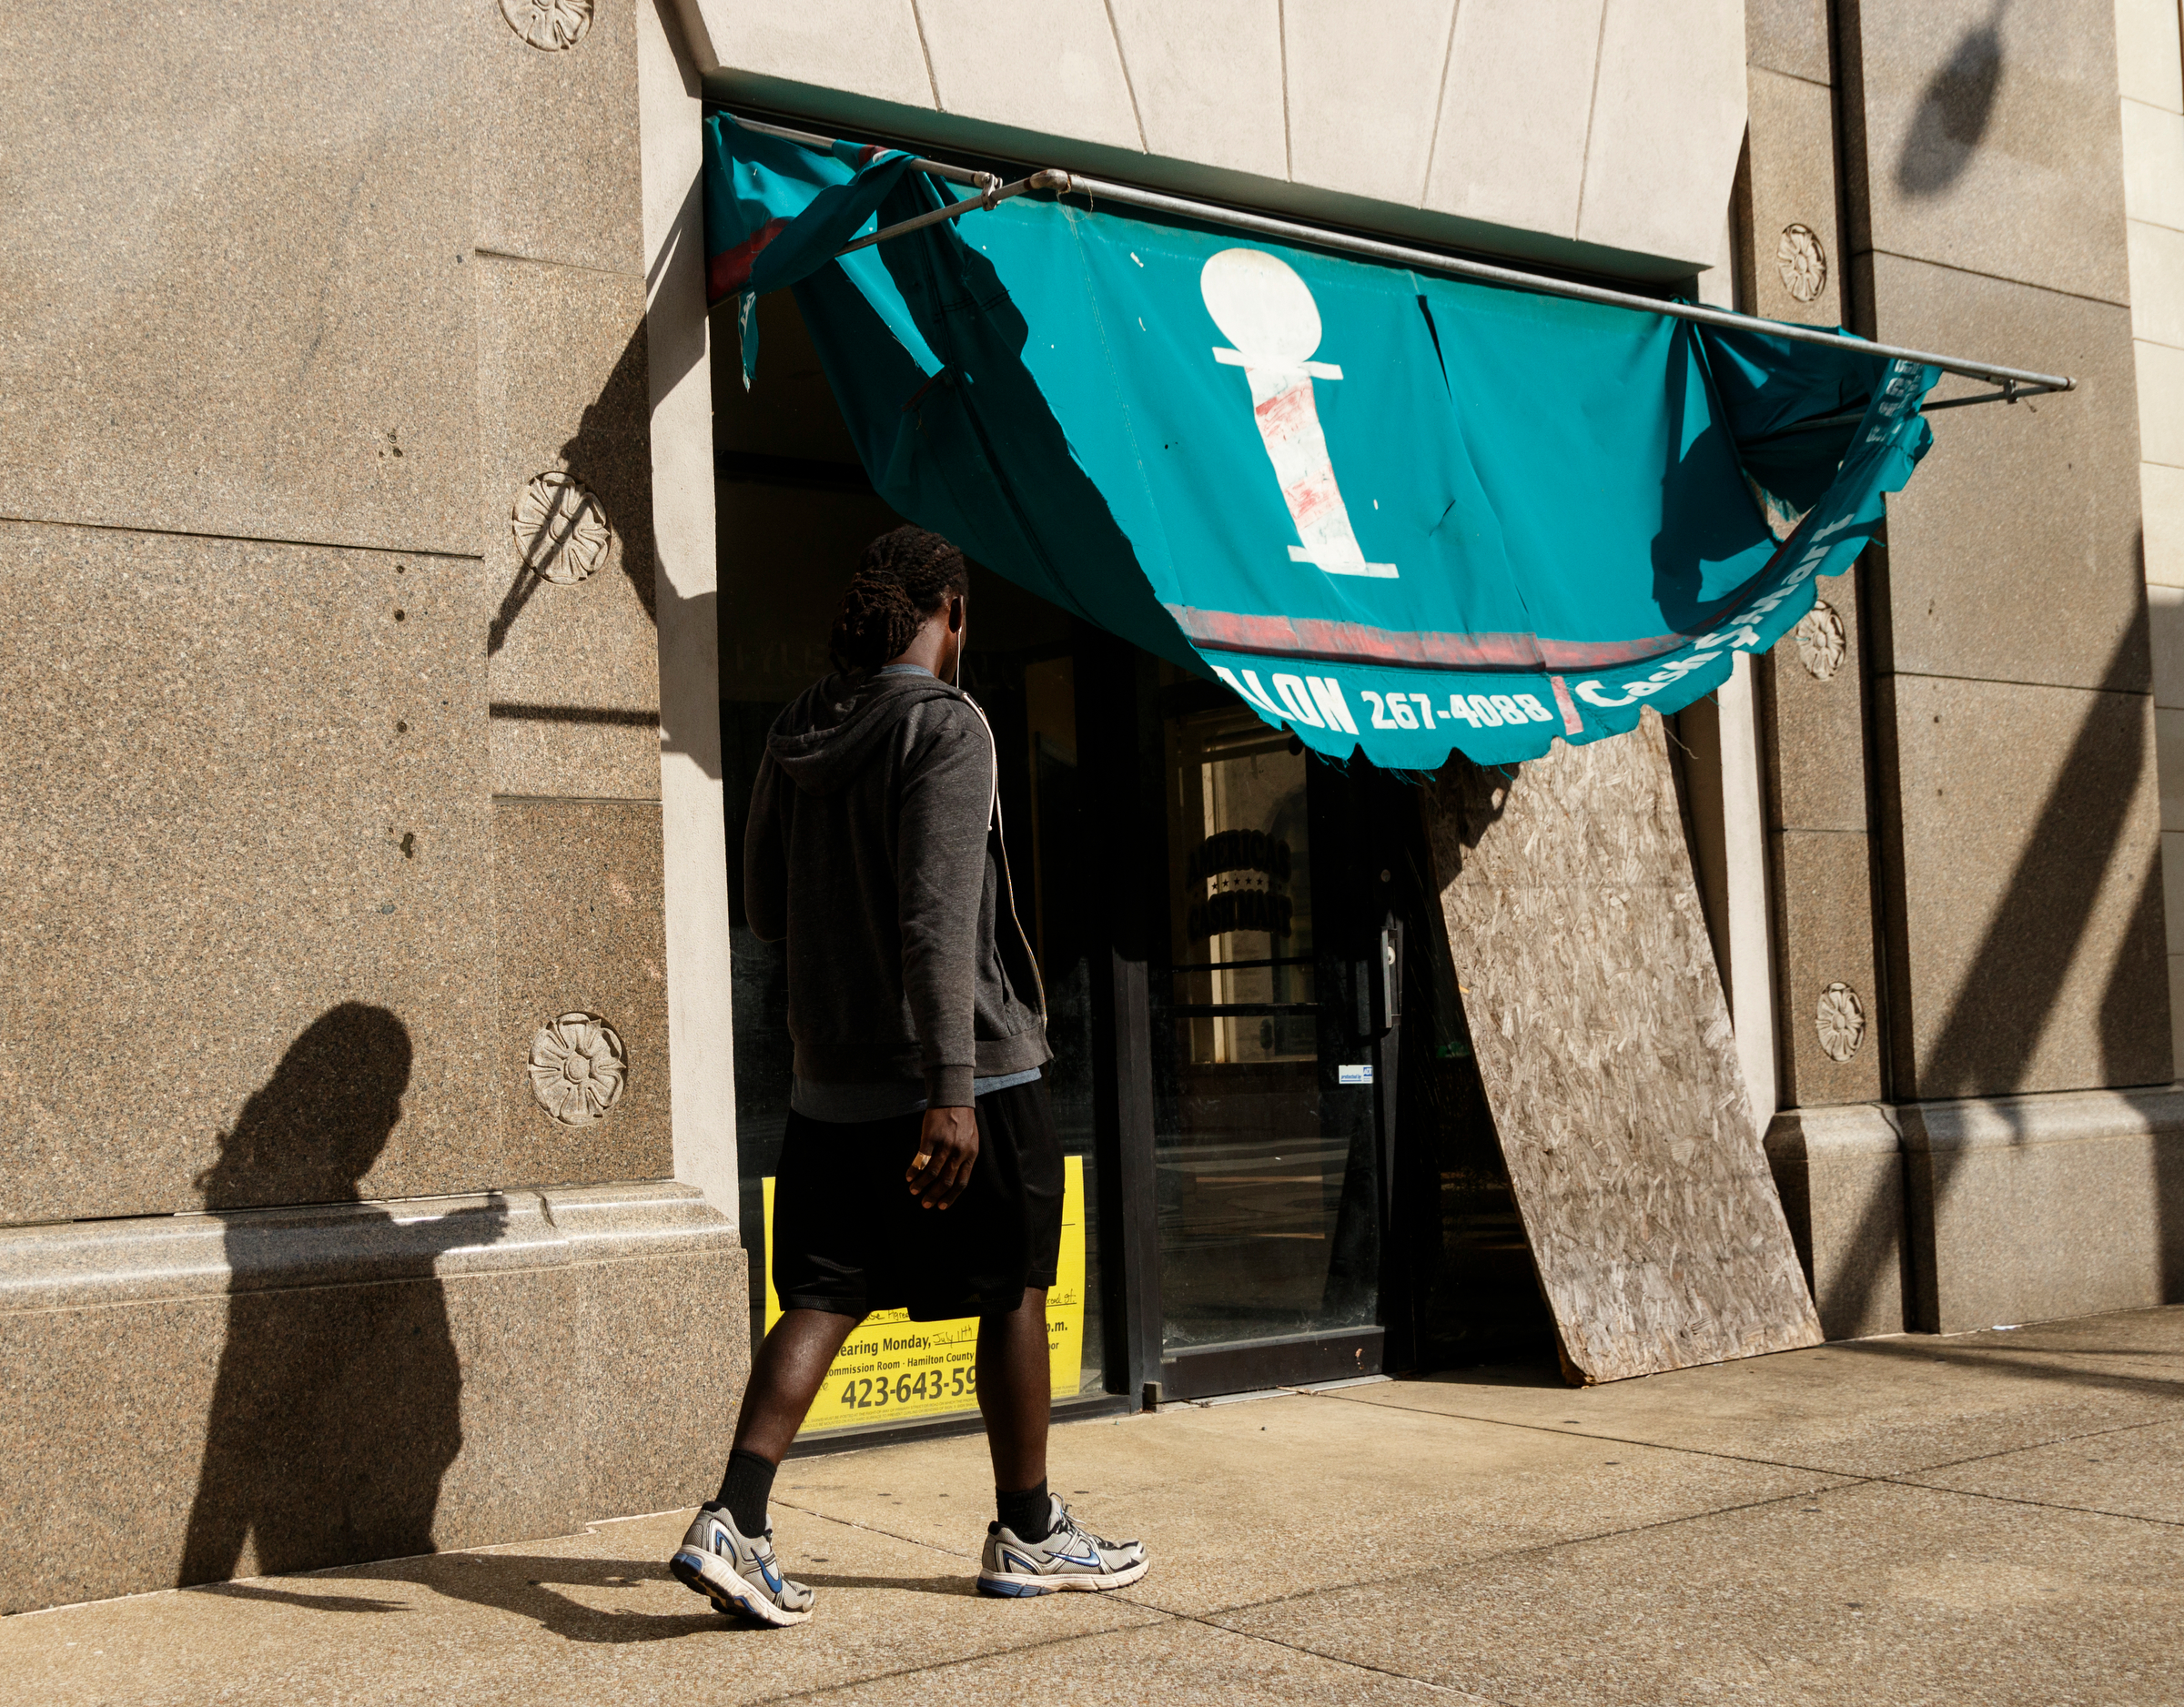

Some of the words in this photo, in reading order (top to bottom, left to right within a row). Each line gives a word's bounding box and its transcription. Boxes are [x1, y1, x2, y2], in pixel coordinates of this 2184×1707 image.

[1360, 691, 1553, 729] 267-4088
[1187, 831, 1290, 890] AMERICAS
[1188, 893, 1235, 941] CASH
[1236, 893, 1292, 938] MART
[825, 1363, 875, 1378] ommission
[877, 1359, 900, 1371] Room
[907, 1354, 944, 1369] Hamilton
[946, 1351, 975, 1364] County
[836, 1340, 878, 1357] earing
[883, 1335, 931, 1352] Monday,
